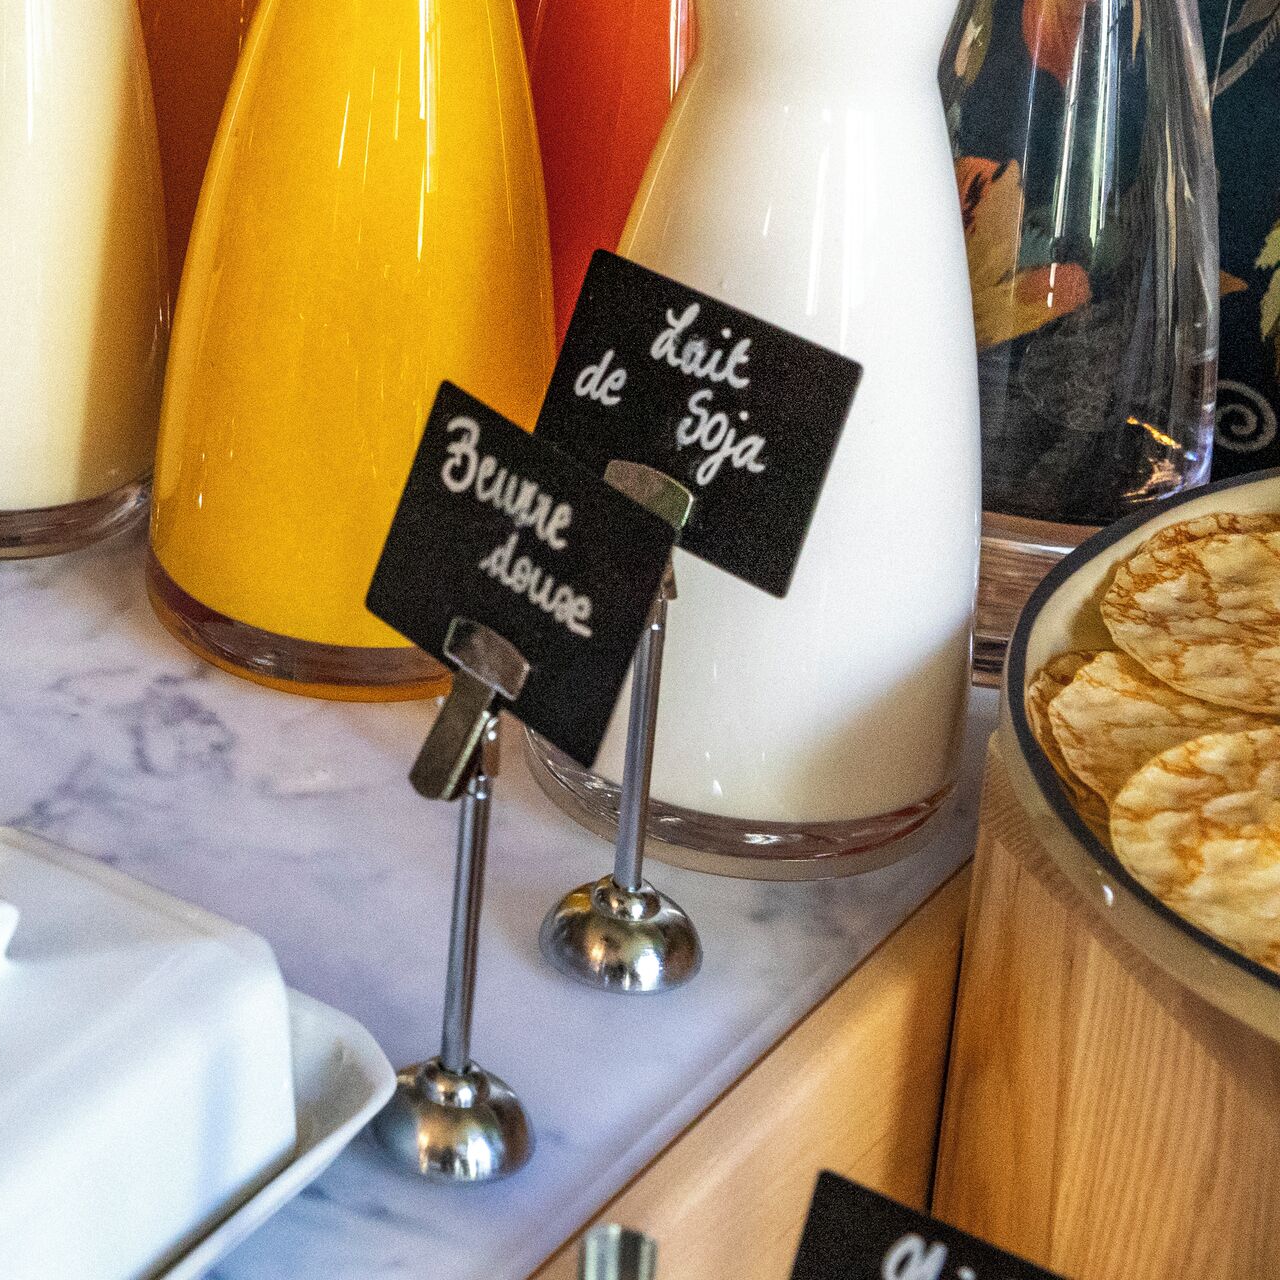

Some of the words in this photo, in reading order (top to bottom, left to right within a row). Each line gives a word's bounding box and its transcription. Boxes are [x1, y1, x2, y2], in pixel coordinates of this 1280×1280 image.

[650, 302, 752, 389] Lait
[439, 416, 573, 551] Beurre
[574, 349, 628, 407] de
[677, 390, 767, 487] Soja
